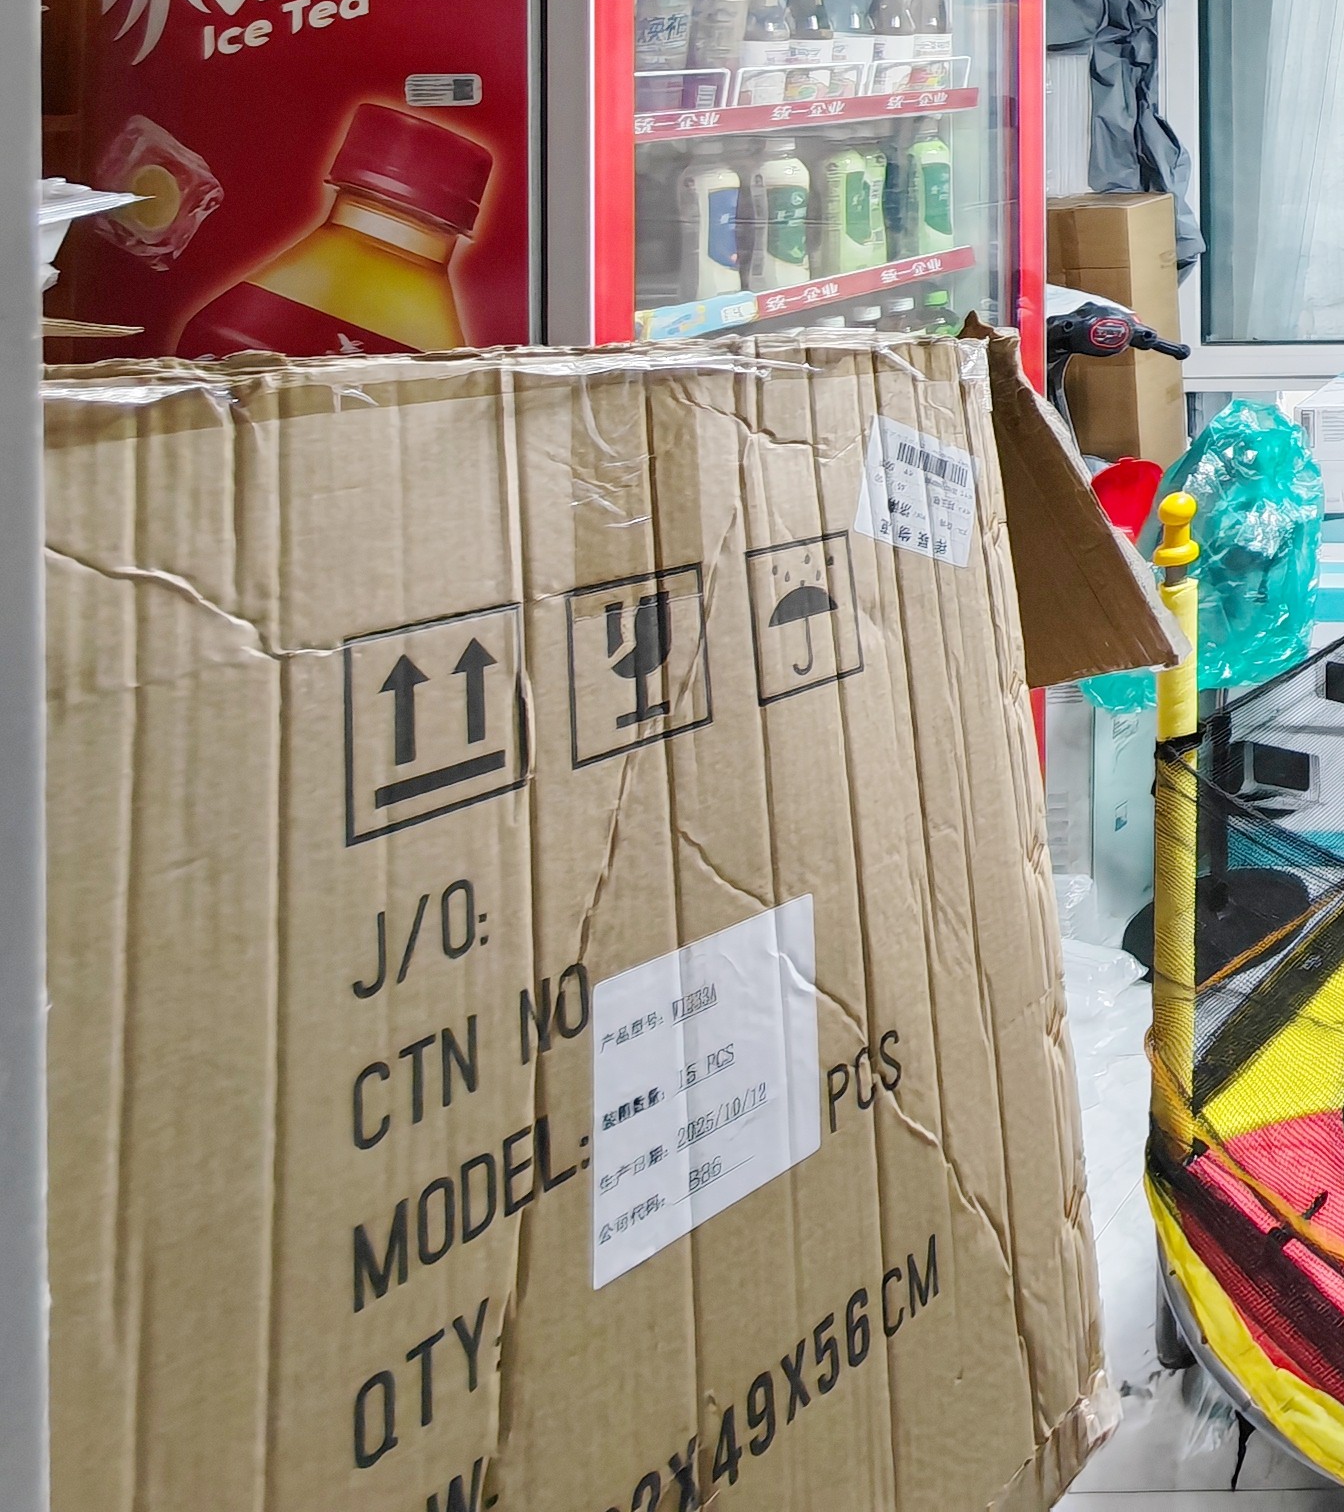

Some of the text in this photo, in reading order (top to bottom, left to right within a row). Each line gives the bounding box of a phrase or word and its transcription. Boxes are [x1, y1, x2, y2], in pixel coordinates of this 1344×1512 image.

[203, 19, 273, 60] Ice
[351, 879, 491, 998] J/O:
[352, 962, 590, 1152] CTN NO
[705, 1042, 736, 1076] PCS
[827, 1029, 904, 1134] PCS
[676, 1082, 768, 1148] 2025/10/12
[352, 1114, 592, 1312] MODEL:
